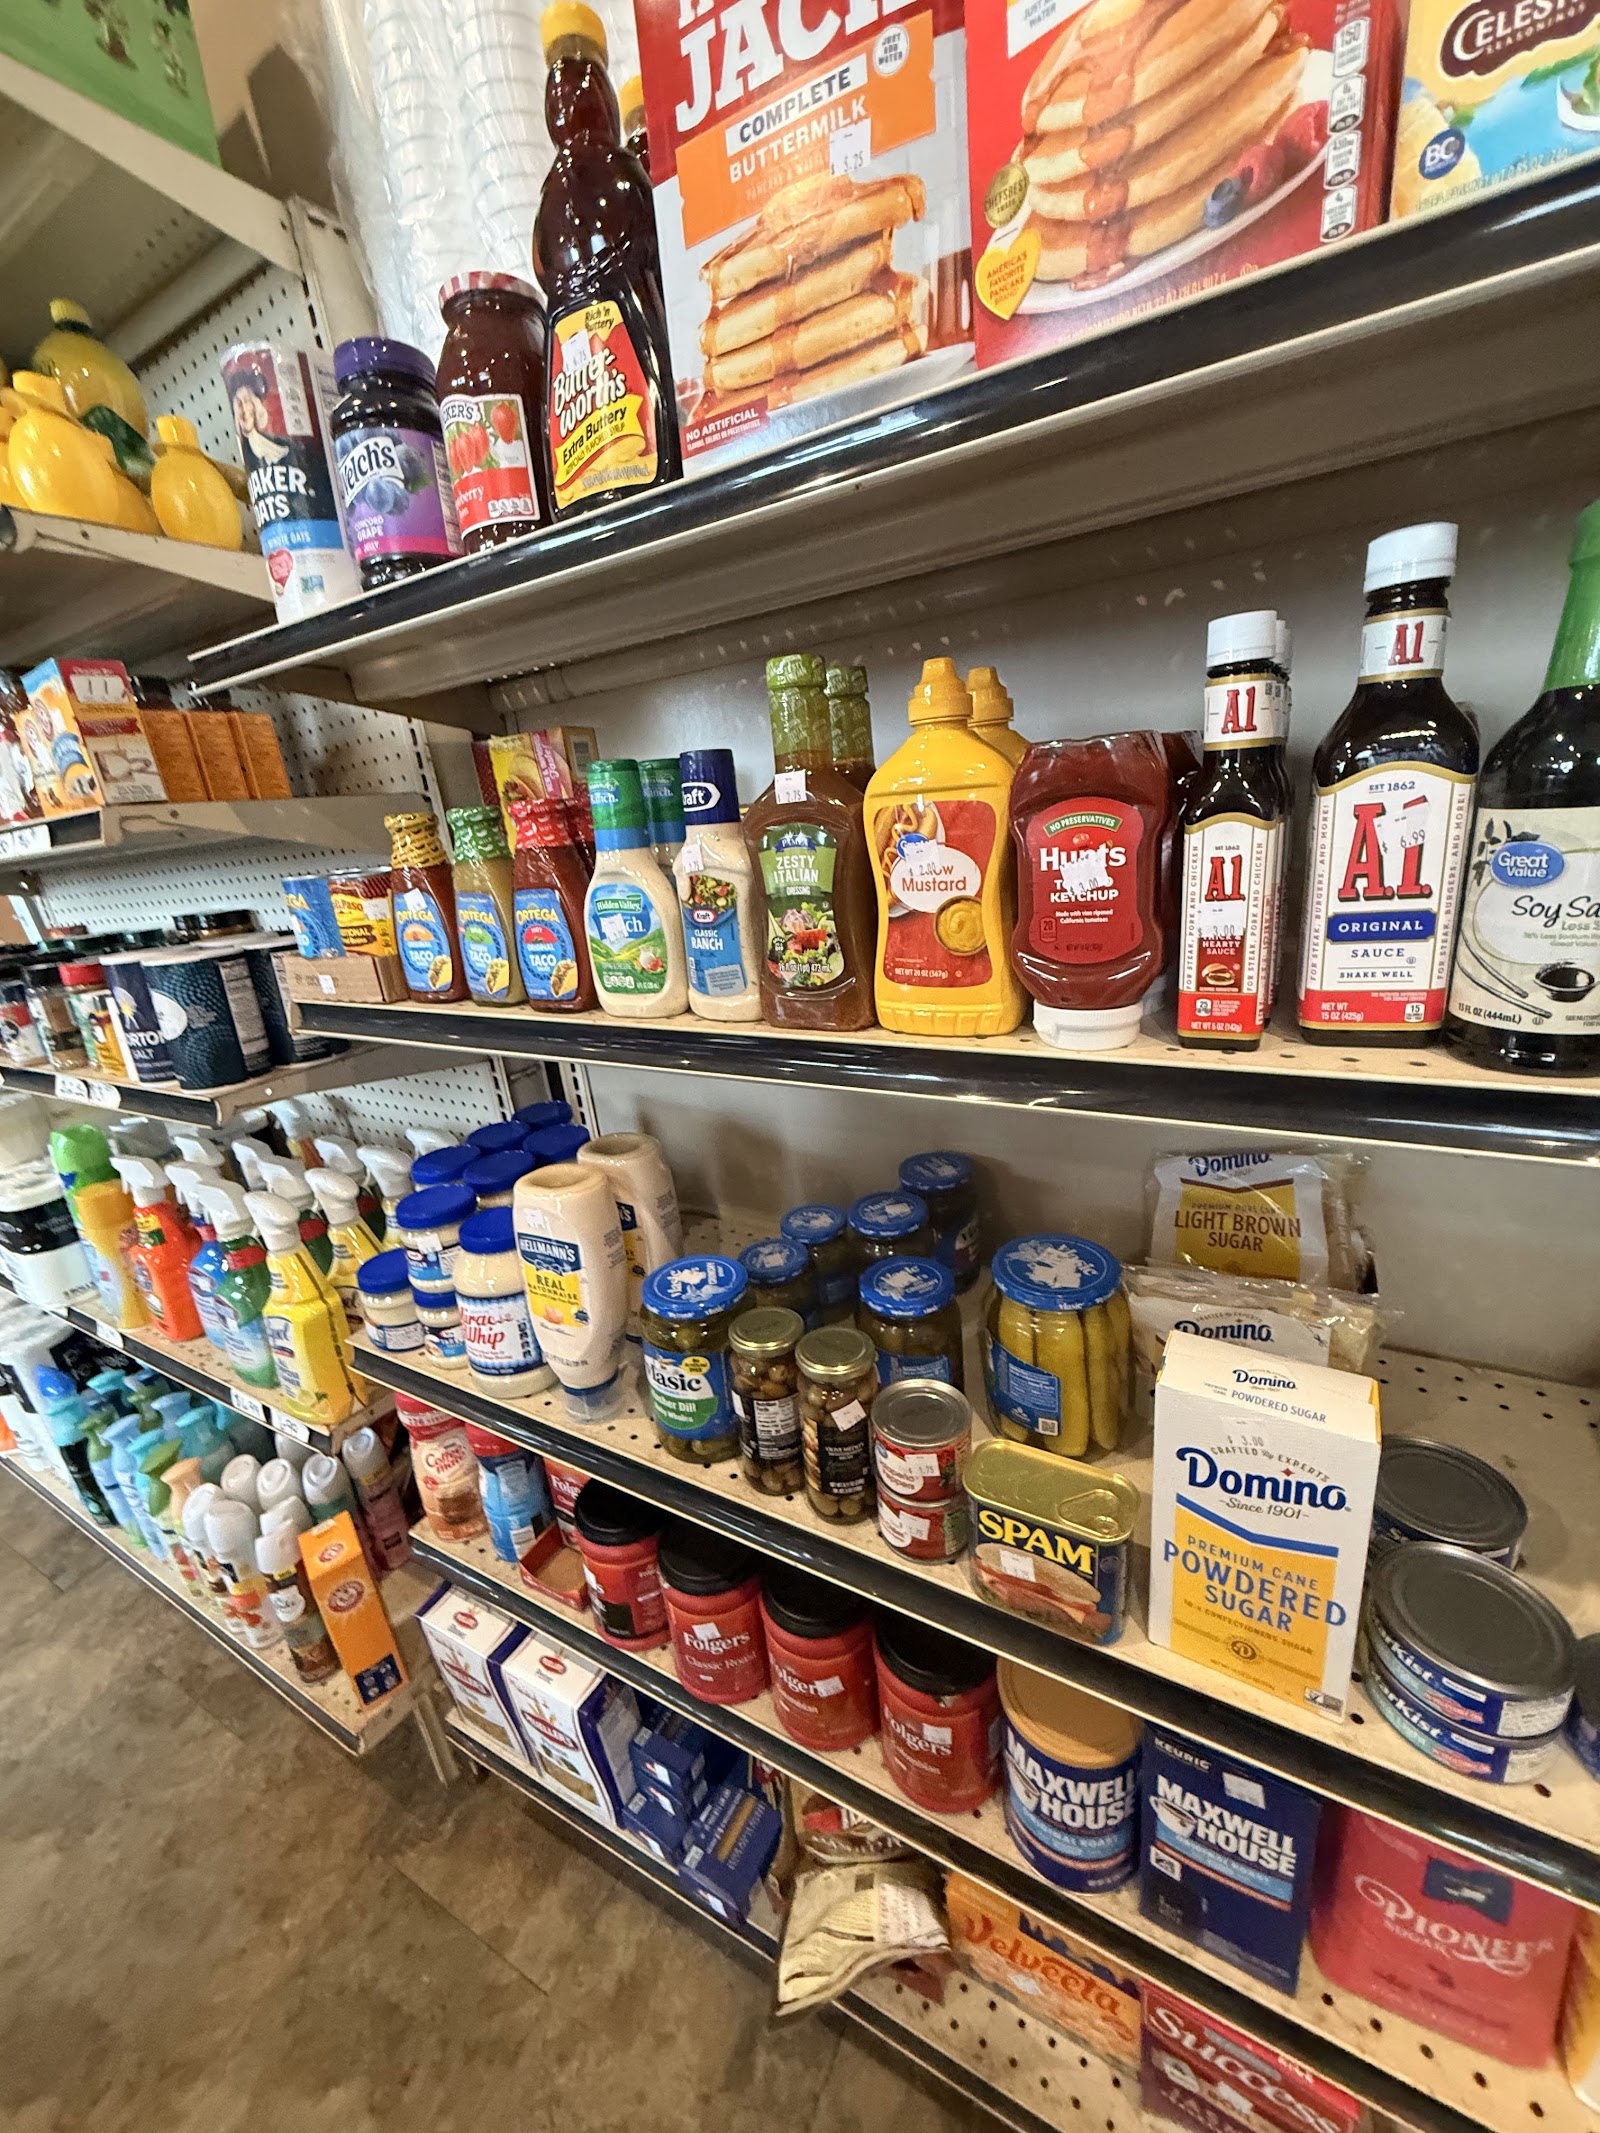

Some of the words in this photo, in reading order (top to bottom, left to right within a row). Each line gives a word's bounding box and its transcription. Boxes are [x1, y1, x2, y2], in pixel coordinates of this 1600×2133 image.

[739, 66, 851, 143] COMPLETE
[730, 95, 867, 183] BUTTERMILK
[559, 369, 626, 438] worth's
[686, 428, 701, 444] NO
[702, 408, 759, 436] ARTIFICIAL
[562, 434, 585, 466] Extra
[585, 405, 628, 441] Buttery
[357, 525, 384, 542] GRAPE
[1368, 784, 1384, 792] EST
[1386, 781, 1416, 792] 1862
[1050, 822, 1061, 832] NO
[1061, 814, 1116, 828] PRESERVATIVES
[1400, 829, 1426, 849] 6.99
[1452, 834, 1460, 857] AND
[776, 855, 815, 869] ZESTY
[1191, 844, 1199, 888] CHICKEN
[1255, 842, 1263, 885] CHICKEN
[1497, 850, 1550, 868] Great
[773, 869, 818, 884] ITALIAN
[1506, 866, 1547, 878] Value
[786, 886, 811, 896] DRESSING
[902, 876, 967, 892] Mustard
[1050, 889, 1120, 903] KETCHUP
[596, 901, 618, 911] Hidden
[618, 900, 641, 912] Valley
[1512, 894, 1562, 928] Soy
[397, 910, 436, 923] ORTEGA
[460, 911, 496, 926] ORTEGA
[516, 908, 561, 925] ORTEGA
[696, 912, 711, 921] Kraft
[1043, 920, 1053, 931] 20
[694, 929, 718, 937] CLASSIC
[1213, 924, 1235, 937] 3.00
[1338, 920, 1424, 933] ORIGINAL
[691, 937, 723, 951] RANCH
[1203, 940, 1242, 948] HEARTY
[1206, 947, 1236, 955] SAUCE
[1351, 947, 1405, 958] SAUCE
[409, 951, 434, 962] TACO
[469, 951, 492, 963] TACO
[529, 954, 557, 967] TACO
[921, 969, 929, 977] OZ
[929, 969, 949, 979] (567g)
[1310, 962, 1318, 981] FOR
[1339, 971, 1377, 979] SHAKE
[1382, 970, 1413, 978] WELL
[1199, 1001, 1209, 1009] 25
[1321, 1001, 1337, 1011] NET
[1338, 1001, 1349, 1011] WT
[1410, 1004, 1420, 1014] 15
[1321, 1011, 1332, 1020] 15
[1332, 1011, 1341, 1020] OZ
[1341, 1011, 1364, 1022] (425g)
[1472, 1007, 1483, 1017] OZ
[1483, 1009, 1522, 1025] (444mL)
[1191, 1022, 1202, 1030] NET
[1202, 1022, 1212, 1031] WT
[1216, 1023, 1225, 1032] OZ
[1225, 1023, 1242, 1033] (142g)
[1188, 1152, 1270, 1177] Domino
[1174, 1210, 1228, 1230] LIGHT
[1233, 1212, 1302, 1238] BROWN
[520, 1238, 576, 1263] HELLMANN'S
[1207, 1231, 1263, 1252] SUGAR
[527, 1282, 579, 1301] MAYONNAISE
[536, 1274, 566, 1292] REAL
[465, 1325, 506, 1350] Whip
[646, 1364, 703, 1392] lasic
[1232, 1368, 1297, 1390] Domino
[678, 1402, 698, 1413] Dill
[1231, 1389, 1289, 1414] POWDERED
[1290, 1405, 1327, 1424] SUGAR
[1210, 1446, 1258, 1457] CRAFTED
[1277, 1454, 1331, 1483] EXPERTS
[1176, 1446, 1347, 1511] Domino
[1226, 1497, 1266, 1514] Since
[1267, 1503, 1302, 1520] 1901
[978, 1509, 1095, 1576] SPAM
[1187, 1534, 1264, 1573] PREMIUM
[1272, 1566, 1320, 1591] CANE
[1163, 1538, 1348, 1627] POWDERED
[1204, 1583, 1293, 1633] SUGAR
[683, 1631, 752, 1655] Folgers
[1154, 1737, 1212, 1772] KEURIG
[1007, 1727, 1136, 1808] MAXWELL
[1039, 1789, 1136, 1831] HOUSE
[1157, 1774, 1297, 1858] MAXWELL
[1195, 1818, 1297, 1878] HOUSE
[964, 1913, 1121, 2017] Velveeta
